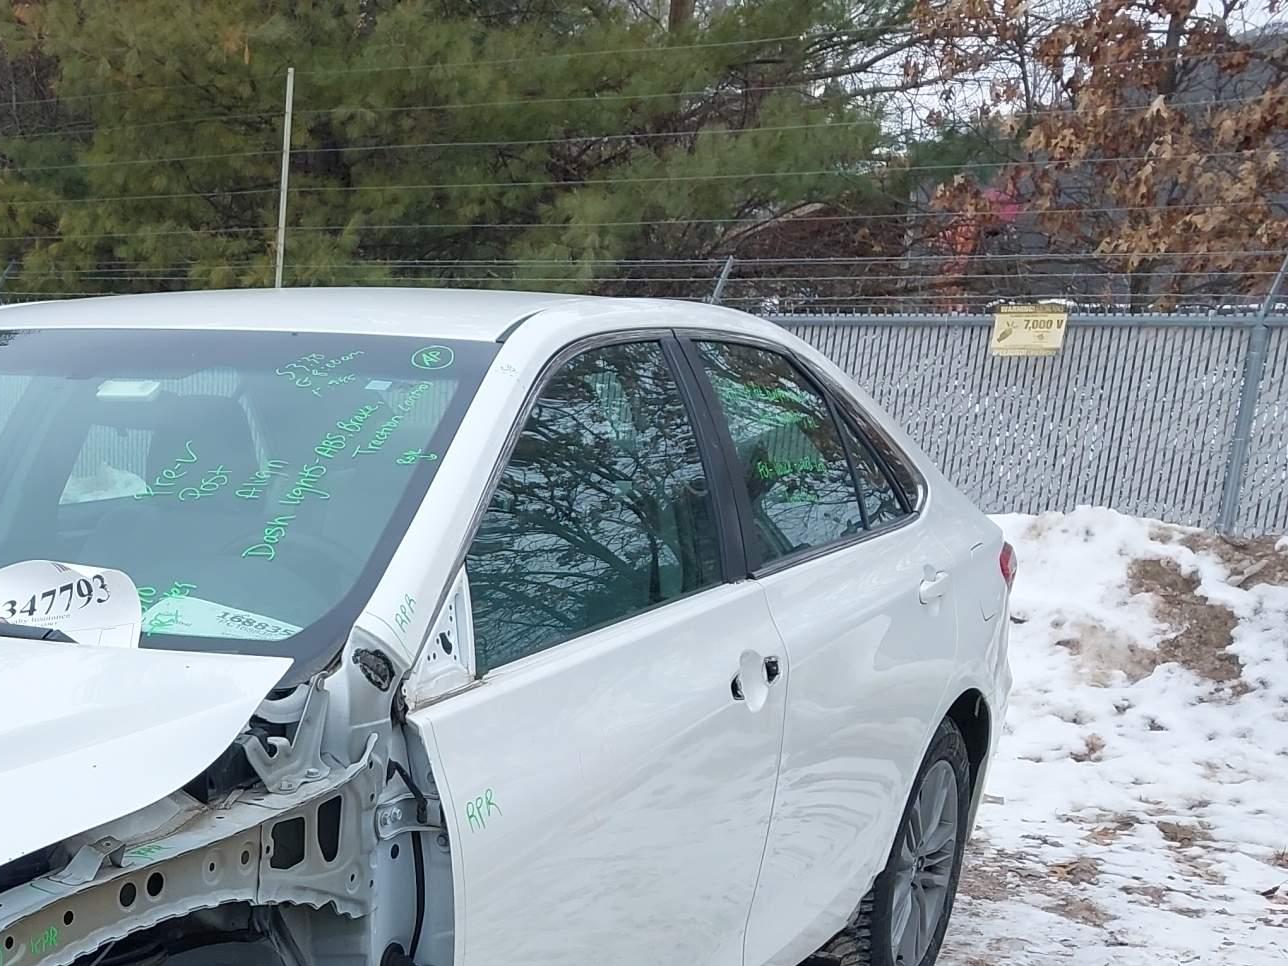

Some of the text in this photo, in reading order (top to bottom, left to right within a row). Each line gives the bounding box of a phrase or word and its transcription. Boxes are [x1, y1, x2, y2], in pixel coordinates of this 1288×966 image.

[1024, 319, 1064, 331] 7,000 V
[241, 515, 296, 561] Dash
[466, 789, 502, 833] RPR
